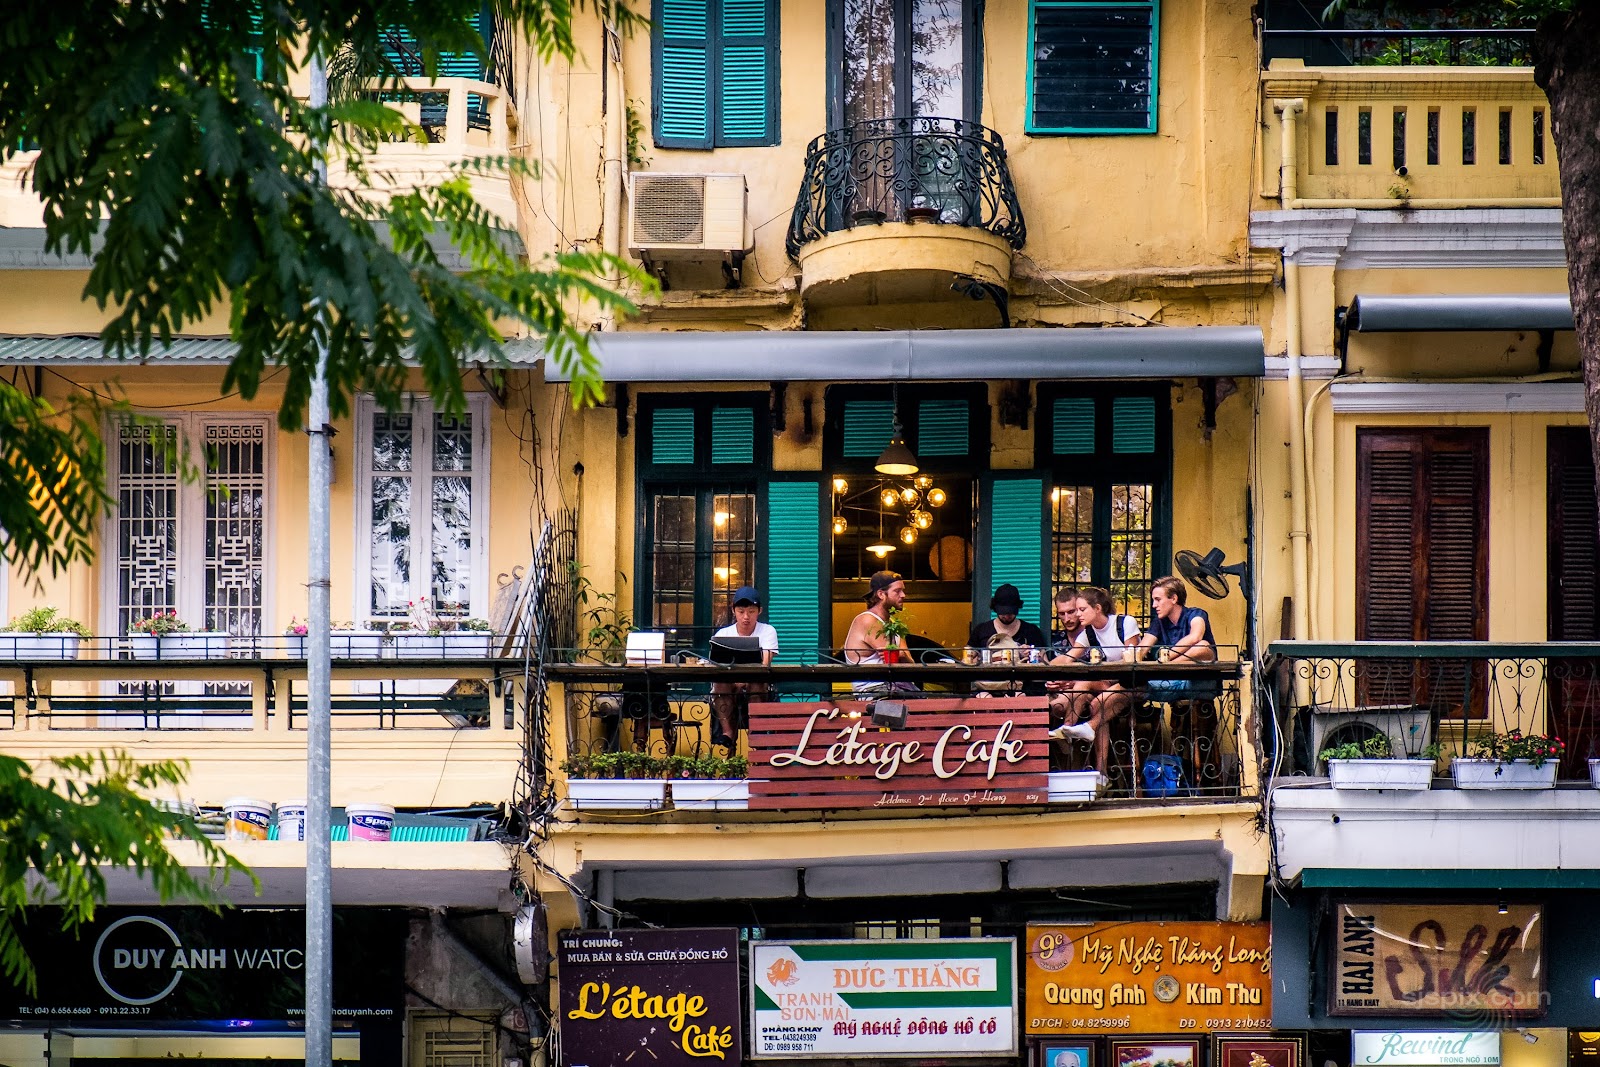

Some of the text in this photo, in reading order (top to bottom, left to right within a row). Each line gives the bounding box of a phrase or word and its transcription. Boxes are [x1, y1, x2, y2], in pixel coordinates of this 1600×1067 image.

[769, 707, 1029, 781] L'étage Cafe
[582, 939, 623, 948] CHUNG:
[114, 949, 304, 969] DUY ANH WATC
[567, 953, 590, 962] MUA
[592, 951, 612, 962] BÁN
[615, 952, 623, 961] &
[1082, 935, 1271, 974] Mỹ Nghệ Thăng Long
[1342, 915, 1375, 994] HAI ANH
[833, 960, 981, 988] ĐỨC THẮNG
[776, 992, 833, 1006] TRANH
[1044, 982, 1146, 1009] Quang Anh
[1186, 982, 1262, 1004] Kim Thu
[19, 1006, 33, 1014] TEL:
[34, 1006, 49, 1015] (04)
[51, 1006, 91, 1014] 6.656.6660
[99, 1006, 151, 1014] 0913.22.33.17
[567, 982, 708, 1032] L'étage
[1031, 1018, 1063, 1028] ĐTCH
[1179, 1018, 1197, 1028] DĐ
[1205, 1018, 1232, 1028] 0913
[681, 1024, 734, 1061] Café
[803, 1043, 814, 1052] 711
[1366, 1032, 1473, 1064] Rewind
[1439, 1056, 1464, 1064] TRONG
